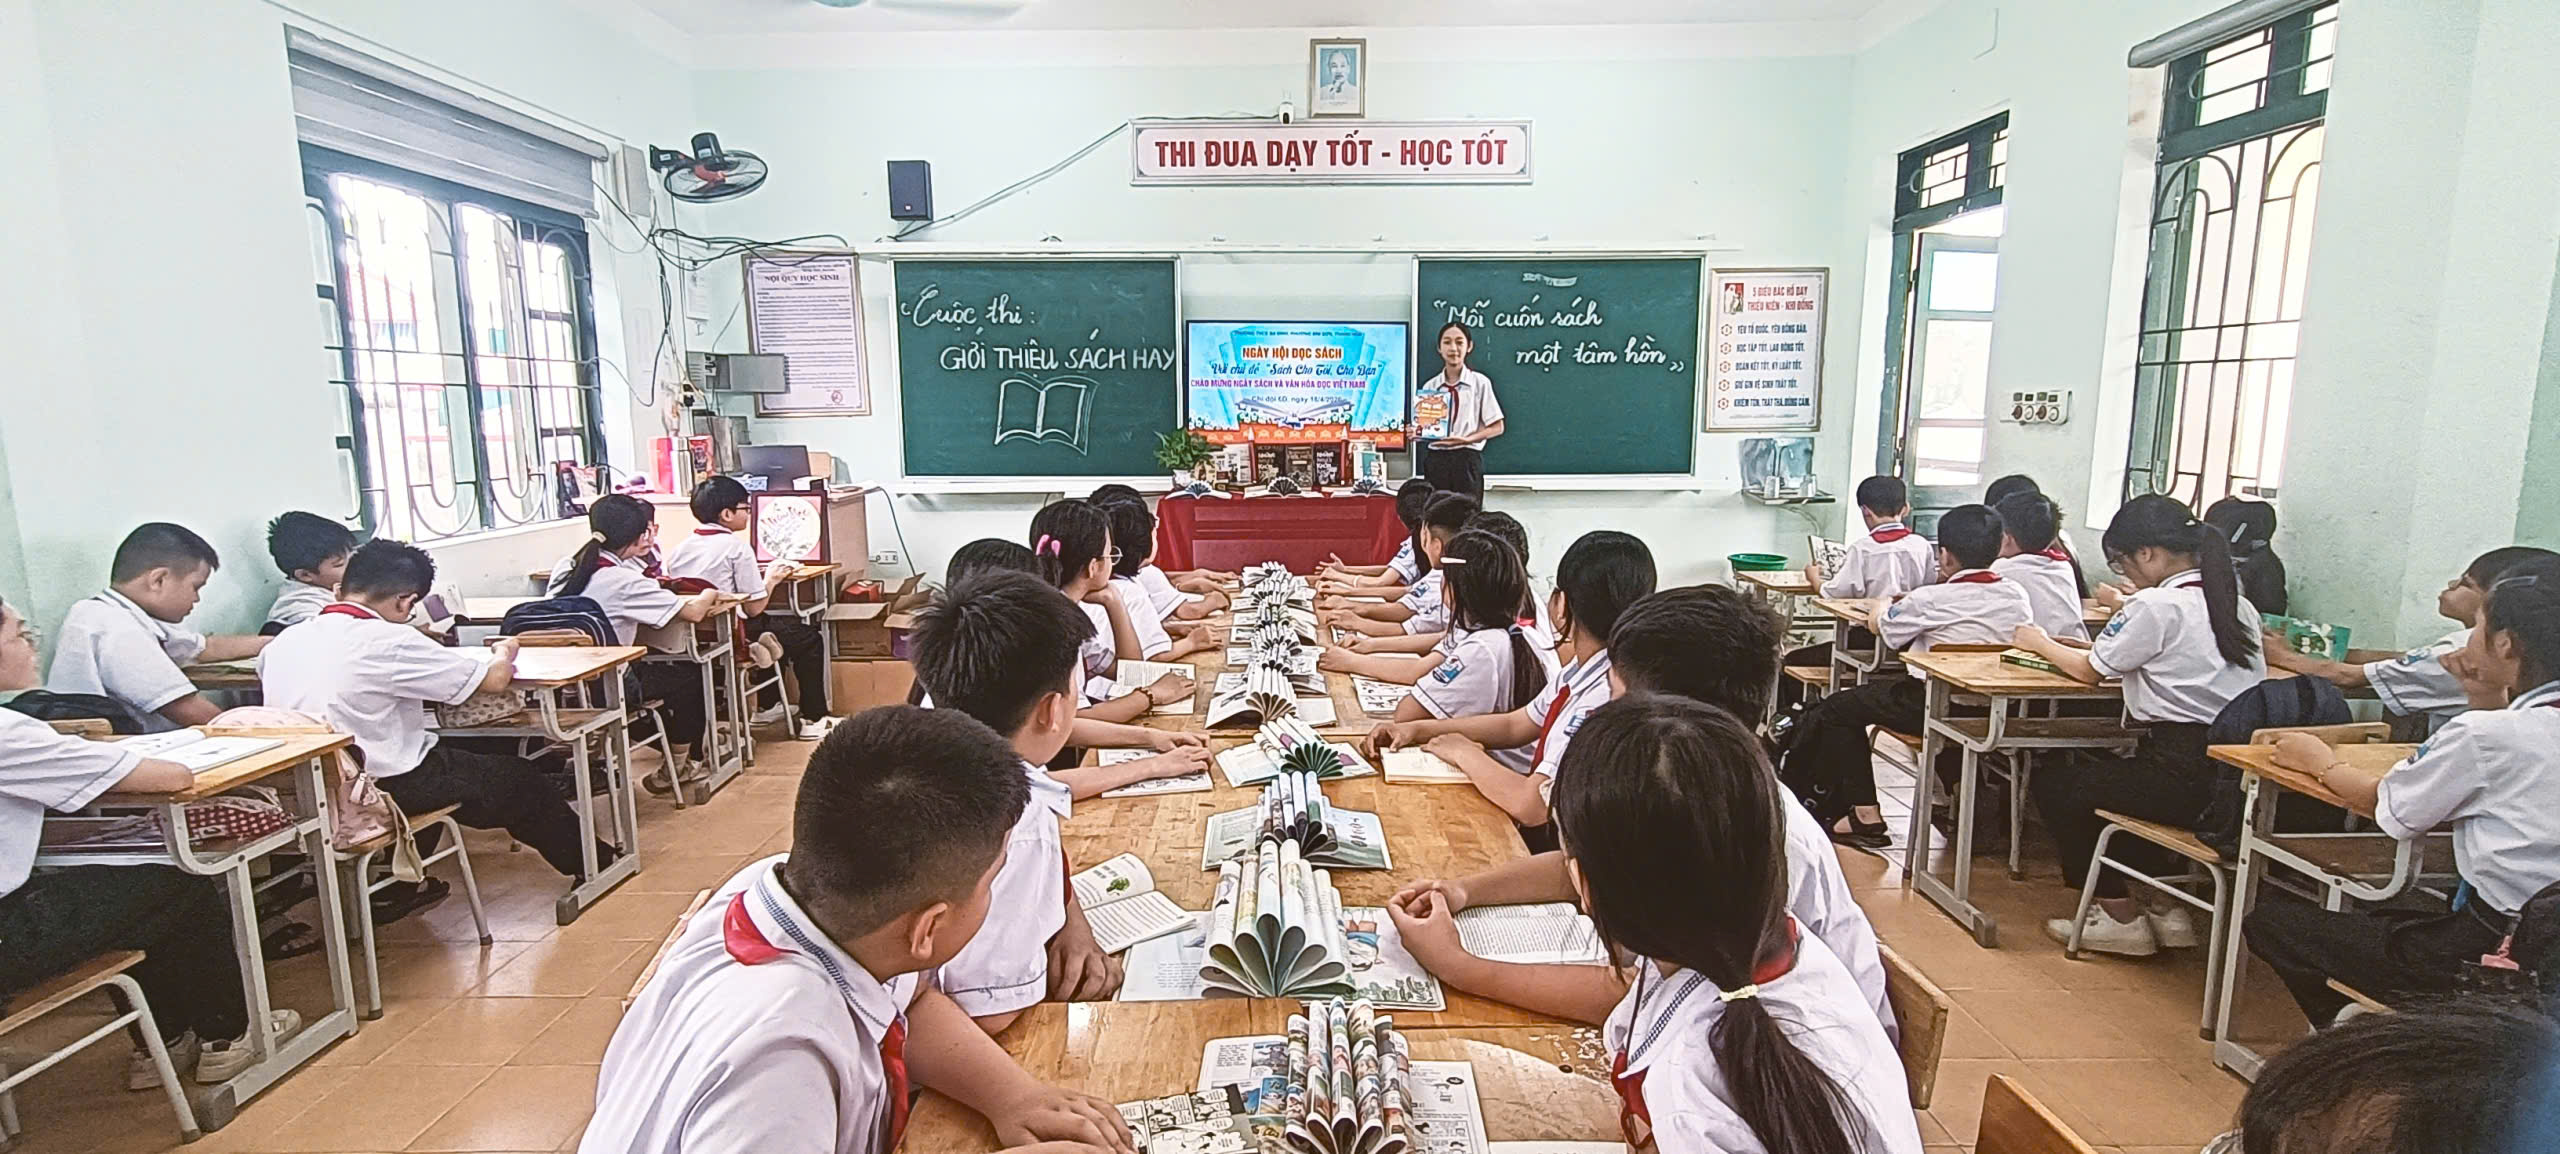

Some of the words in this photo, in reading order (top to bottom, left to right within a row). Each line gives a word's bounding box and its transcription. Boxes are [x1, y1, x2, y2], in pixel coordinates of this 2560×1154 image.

[1155, 141, 1194, 167] THI
[1204, 140, 1257, 167] ĐUA
[1267, 140, 1317, 172] DẠY
[1326, 130, 1372, 166] TỐT
[1401, 140, 1452, 171] HỌC
[1462, 129, 1508, 166] TỐT
[1495, 294, 1545, 328] cuốn
[1550, 296, 1603, 328] sách
[993, 338, 1059, 378] THIỆU
[1064, 328, 1126, 370] SÁCH
[1133, 348, 1176, 370] HAY
[1242, 345, 1269, 358] NGÀY
[1272, 345, 1289, 360] HỘI
[1315, 346, 1342, 358] SÁCH
[1516, 340, 1562, 372] một
[1572, 340, 1618, 365] tâm
[1233, 379, 1252, 388] NGÀY
[1255, 379, 1273, 388] SÁCH
[1274, 379, 1283, 388] VÀ
[1285, 379, 1299, 388] VĂN
[1349, 380, 1365, 389] NAM
[1295, 364, 1313, 375] Cho
[1336, 364, 1354, 375] Cho
